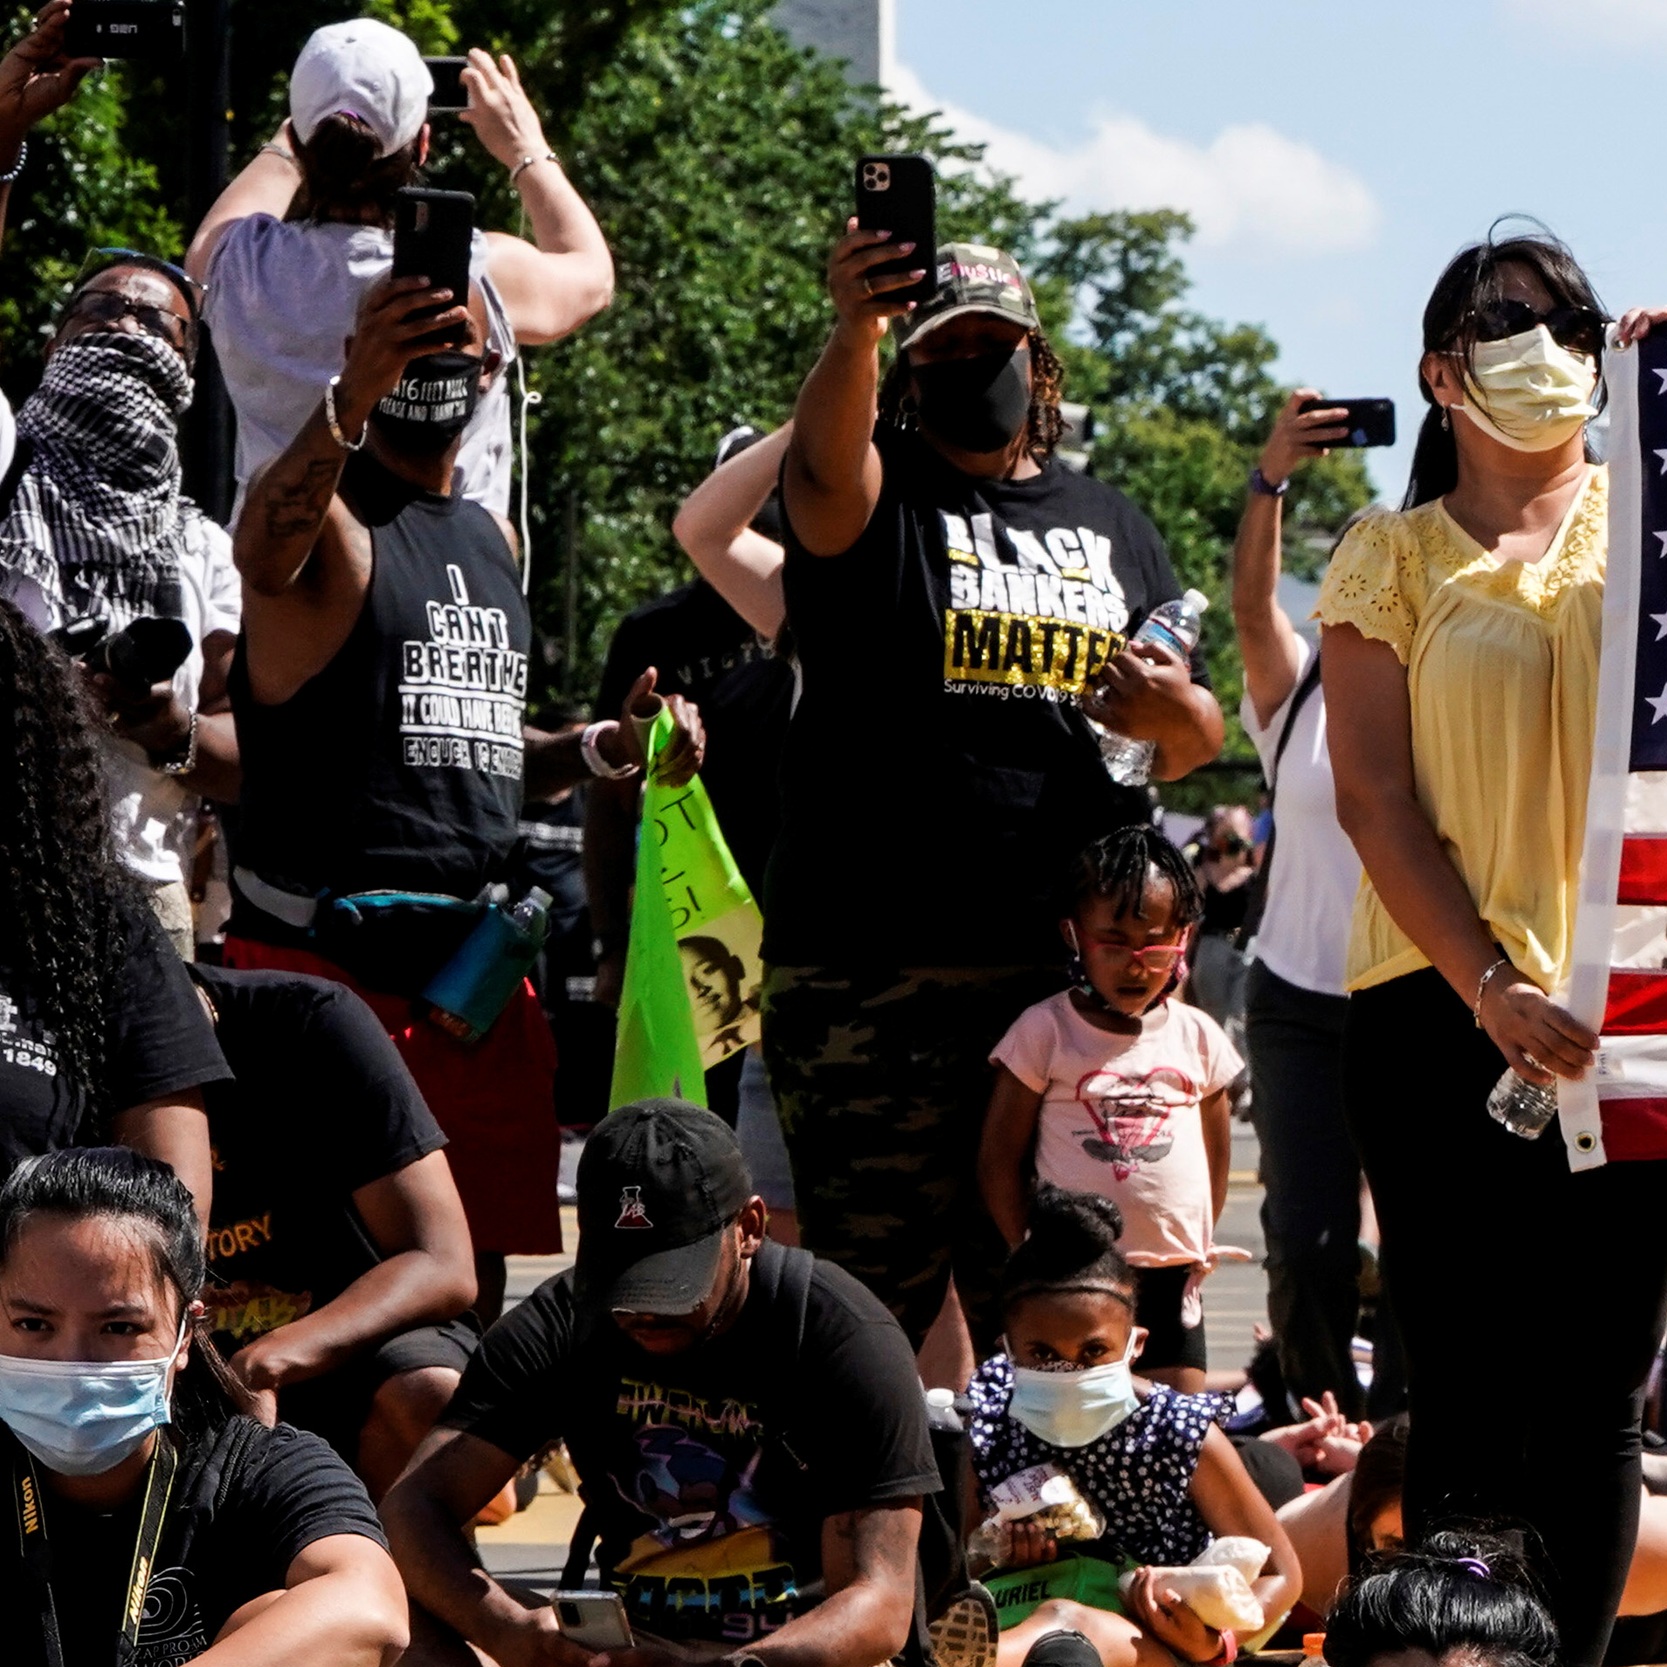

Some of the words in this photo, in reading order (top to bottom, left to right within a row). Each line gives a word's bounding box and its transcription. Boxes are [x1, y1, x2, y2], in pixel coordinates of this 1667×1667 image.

[407, 378, 420, 400] 6
[943, 512, 1125, 600] BLACK
[446, 564, 469, 606] I
[951, 564, 1129, 633] BANKERS
[403, 641, 528, 698] BREATHE
[943, 680, 1009, 701] Surviving
[402, 695, 416, 724] IT
[420, 694, 461, 726] COULD
[403, 737, 472, 770] ENOUGH
[3, 1048, 57, 1077] 1849
[21, 1476, 39, 1535] Nikon
[128, 1556, 150, 1625] Nikon
